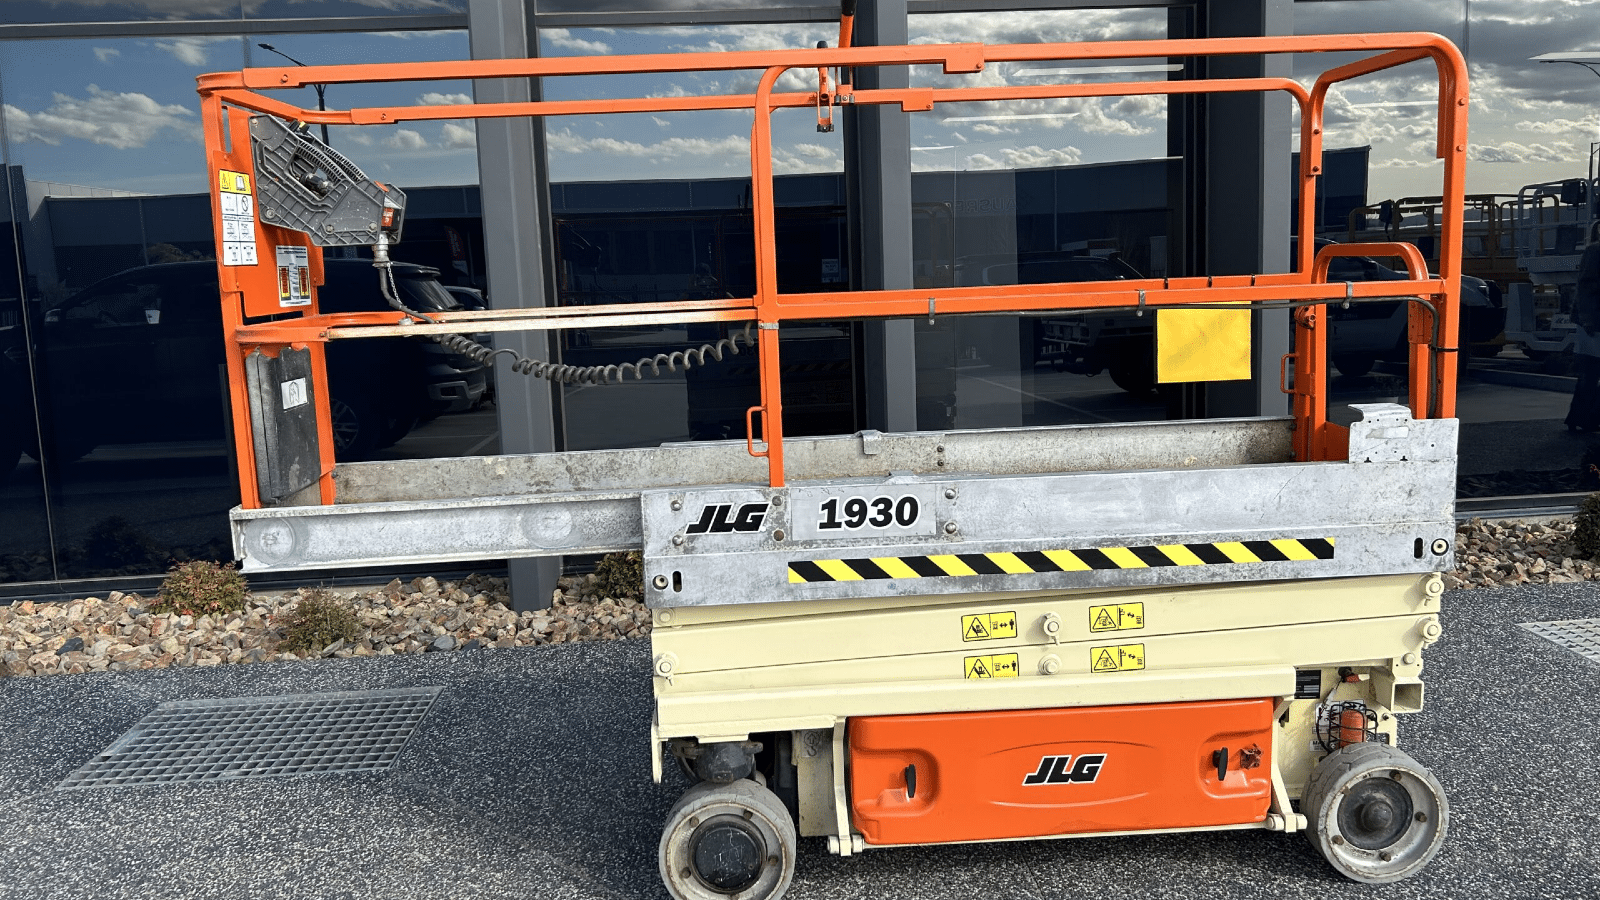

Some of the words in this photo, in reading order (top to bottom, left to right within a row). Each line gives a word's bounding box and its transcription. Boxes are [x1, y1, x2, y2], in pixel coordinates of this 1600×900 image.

[685, 503, 770, 534] JLG
[818, 496, 919, 530] 1930
[1023, 754, 1106, 785] JLG
